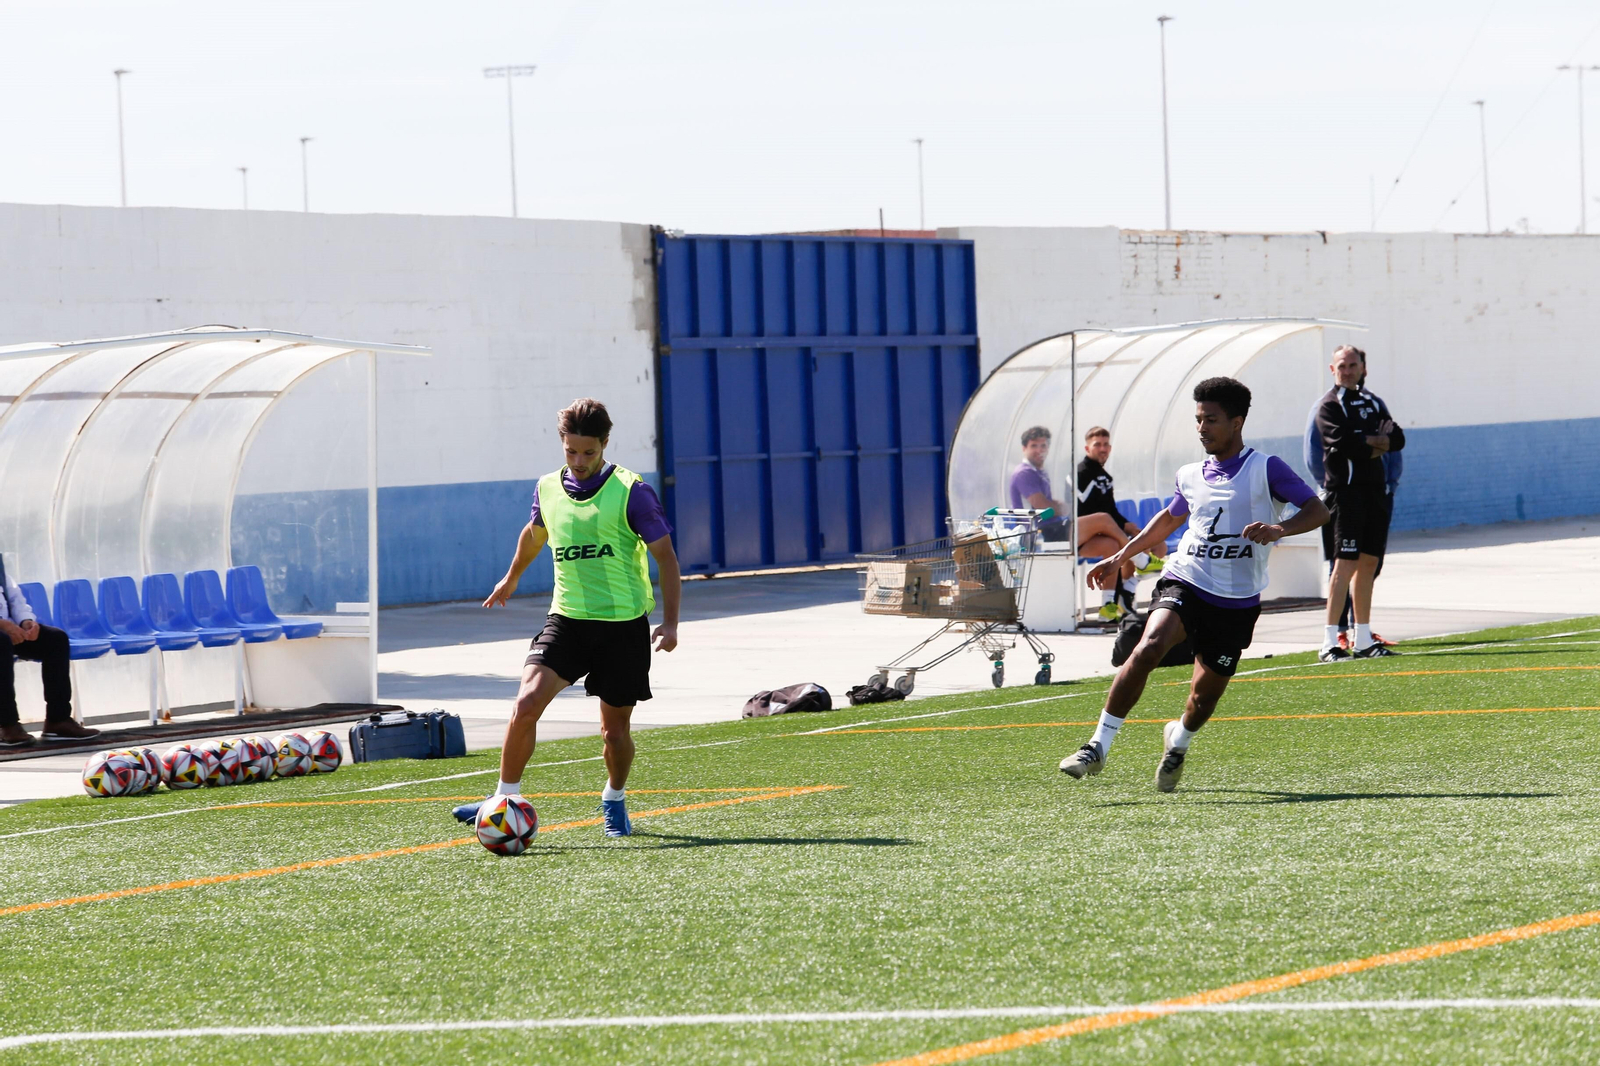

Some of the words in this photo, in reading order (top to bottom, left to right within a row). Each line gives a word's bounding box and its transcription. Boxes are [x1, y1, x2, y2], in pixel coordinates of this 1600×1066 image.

[554, 543, 615, 562] EGEA
[1187, 544, 1253, 559] LEGEA
[1217, 655, 1233, 666] 25
